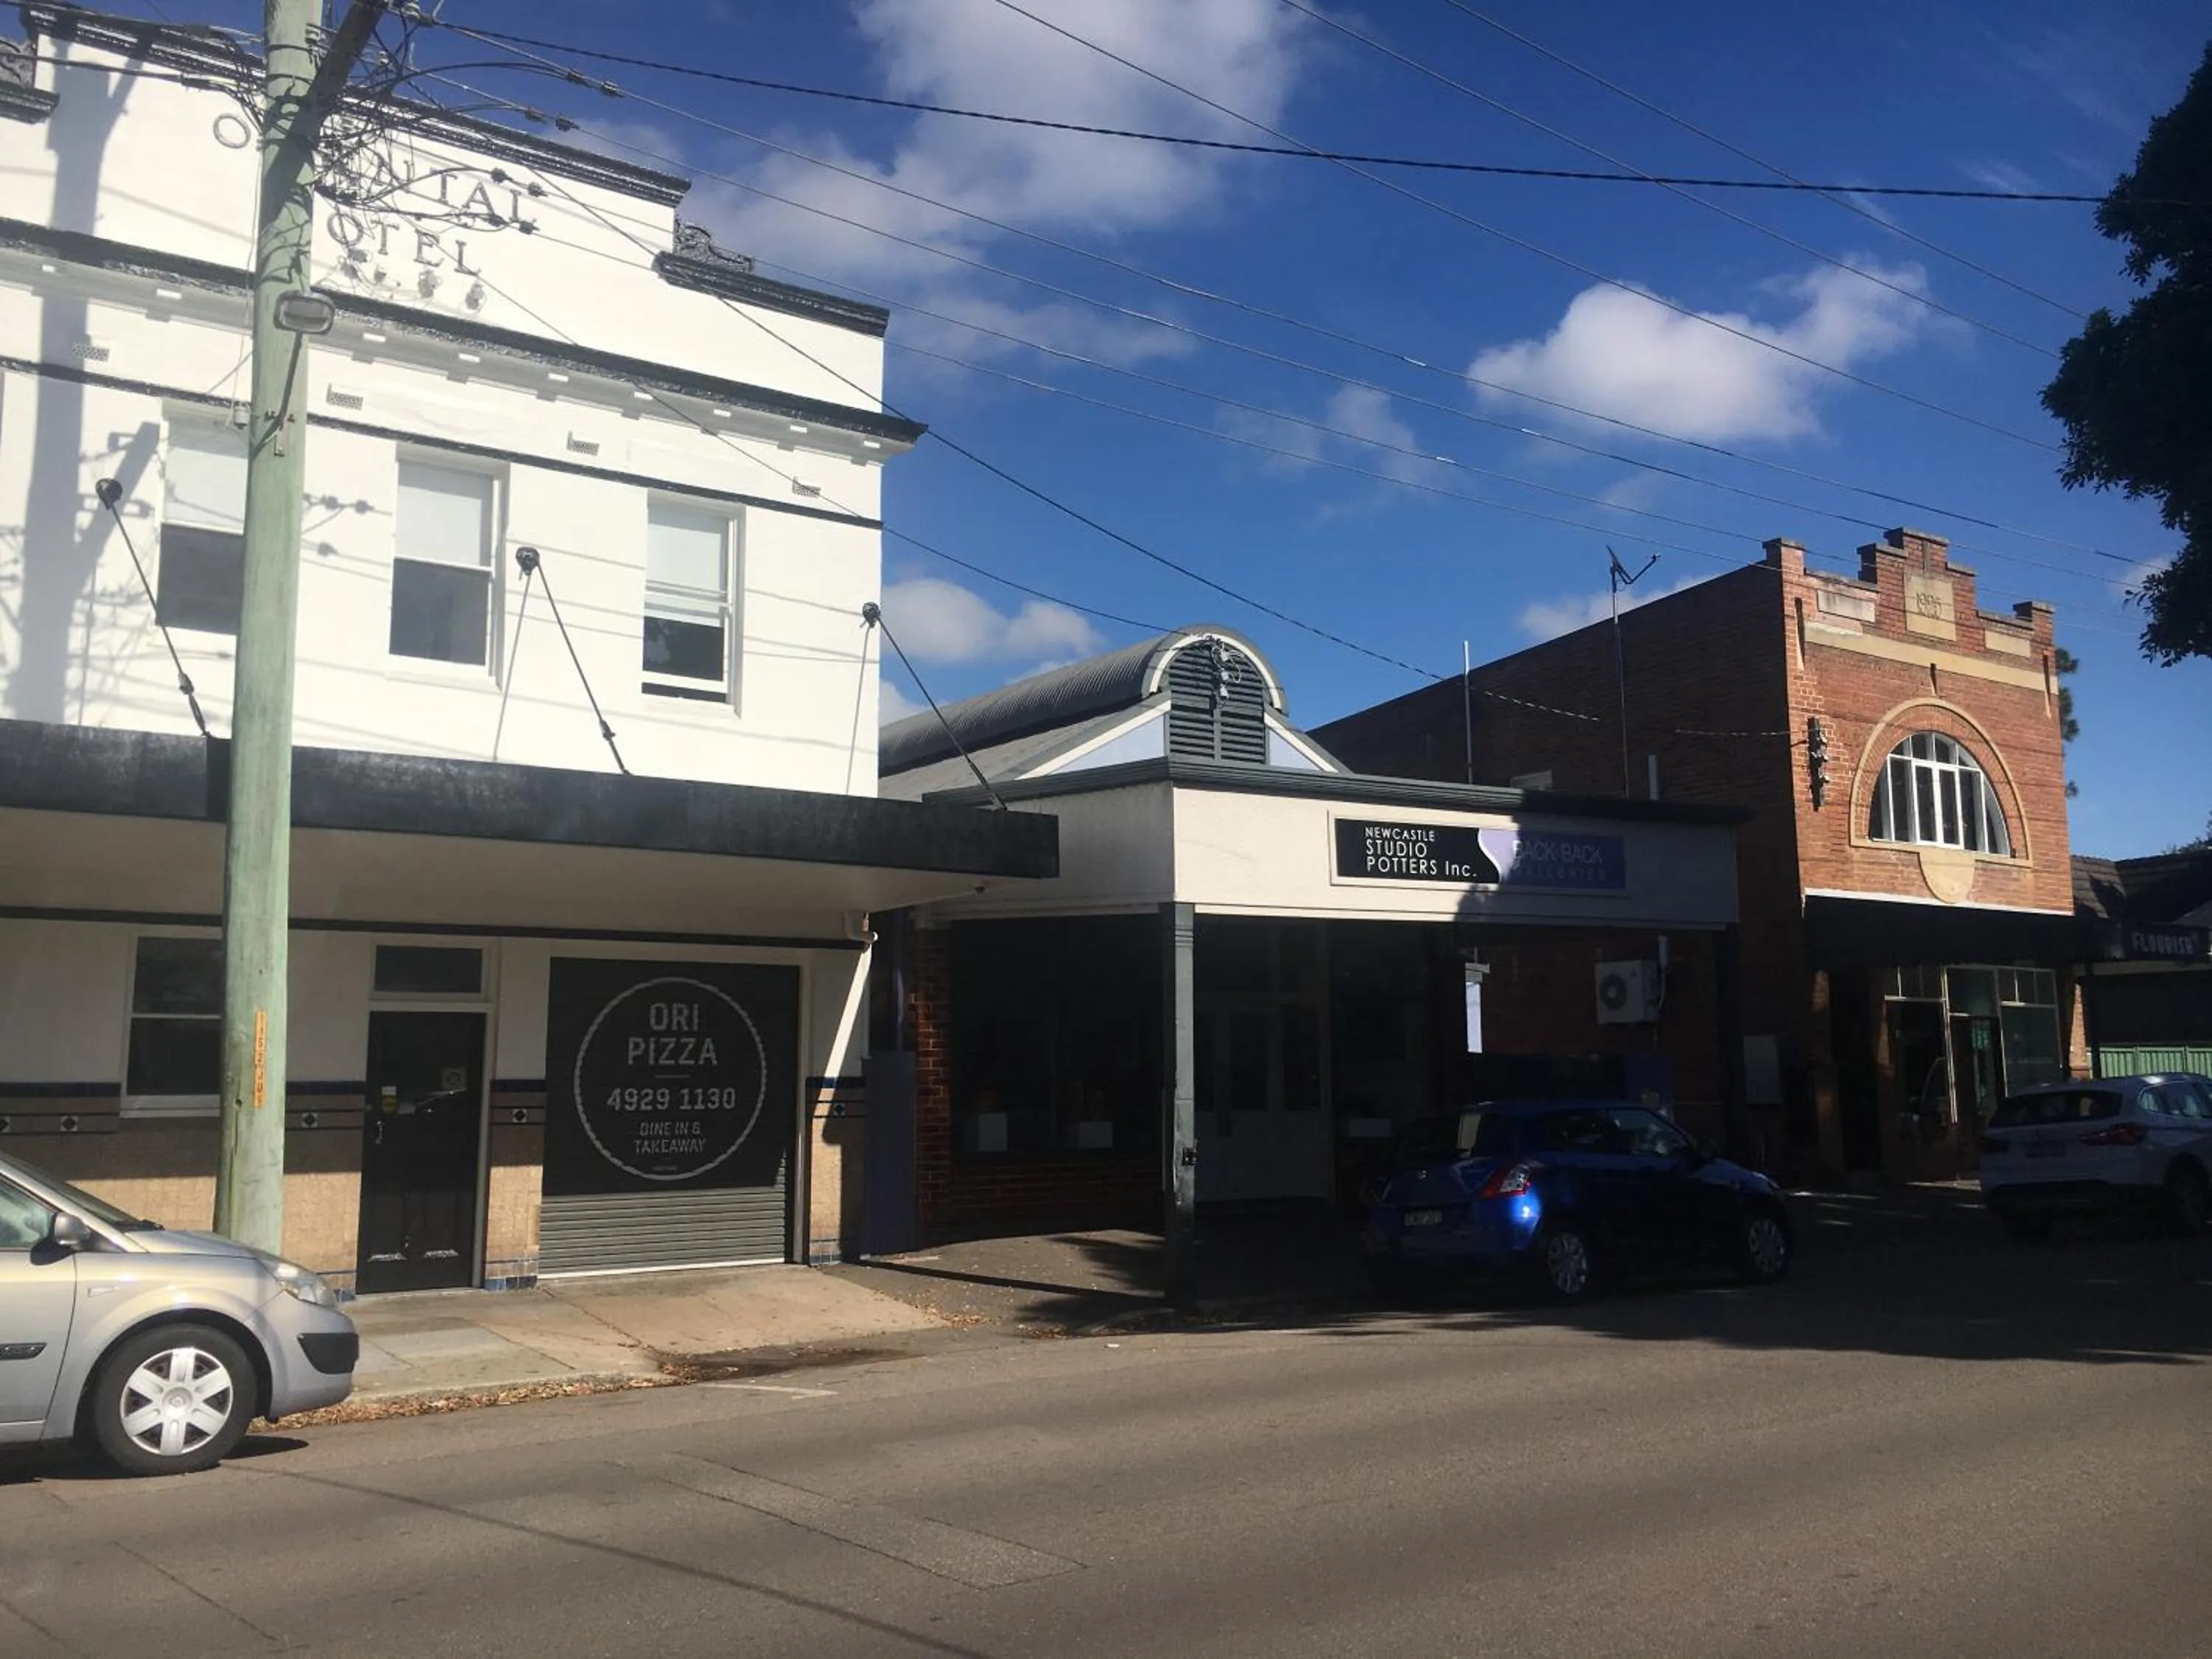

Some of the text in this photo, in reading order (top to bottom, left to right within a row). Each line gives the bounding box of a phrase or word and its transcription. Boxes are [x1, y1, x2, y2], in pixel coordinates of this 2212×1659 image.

[327, 211, 481, 276] OTEL
[1365, 827, 1435, 841] NEWCASTLE
[1366, 839, 1427, 858] STUDIO
[1367, 856, 1477, 877] POTTERS Inc.
[650, 1002, 700, 1032] ORI
[628, 1037, 718, 1065] PIZZA
[607, 1087, 736, 1111] 4929 1130
[640, 1121, 672, 1136] DINE
[675, 1121, 690, 1135] IN
[634, 1138, 706, 1155] TAKEAWAY
